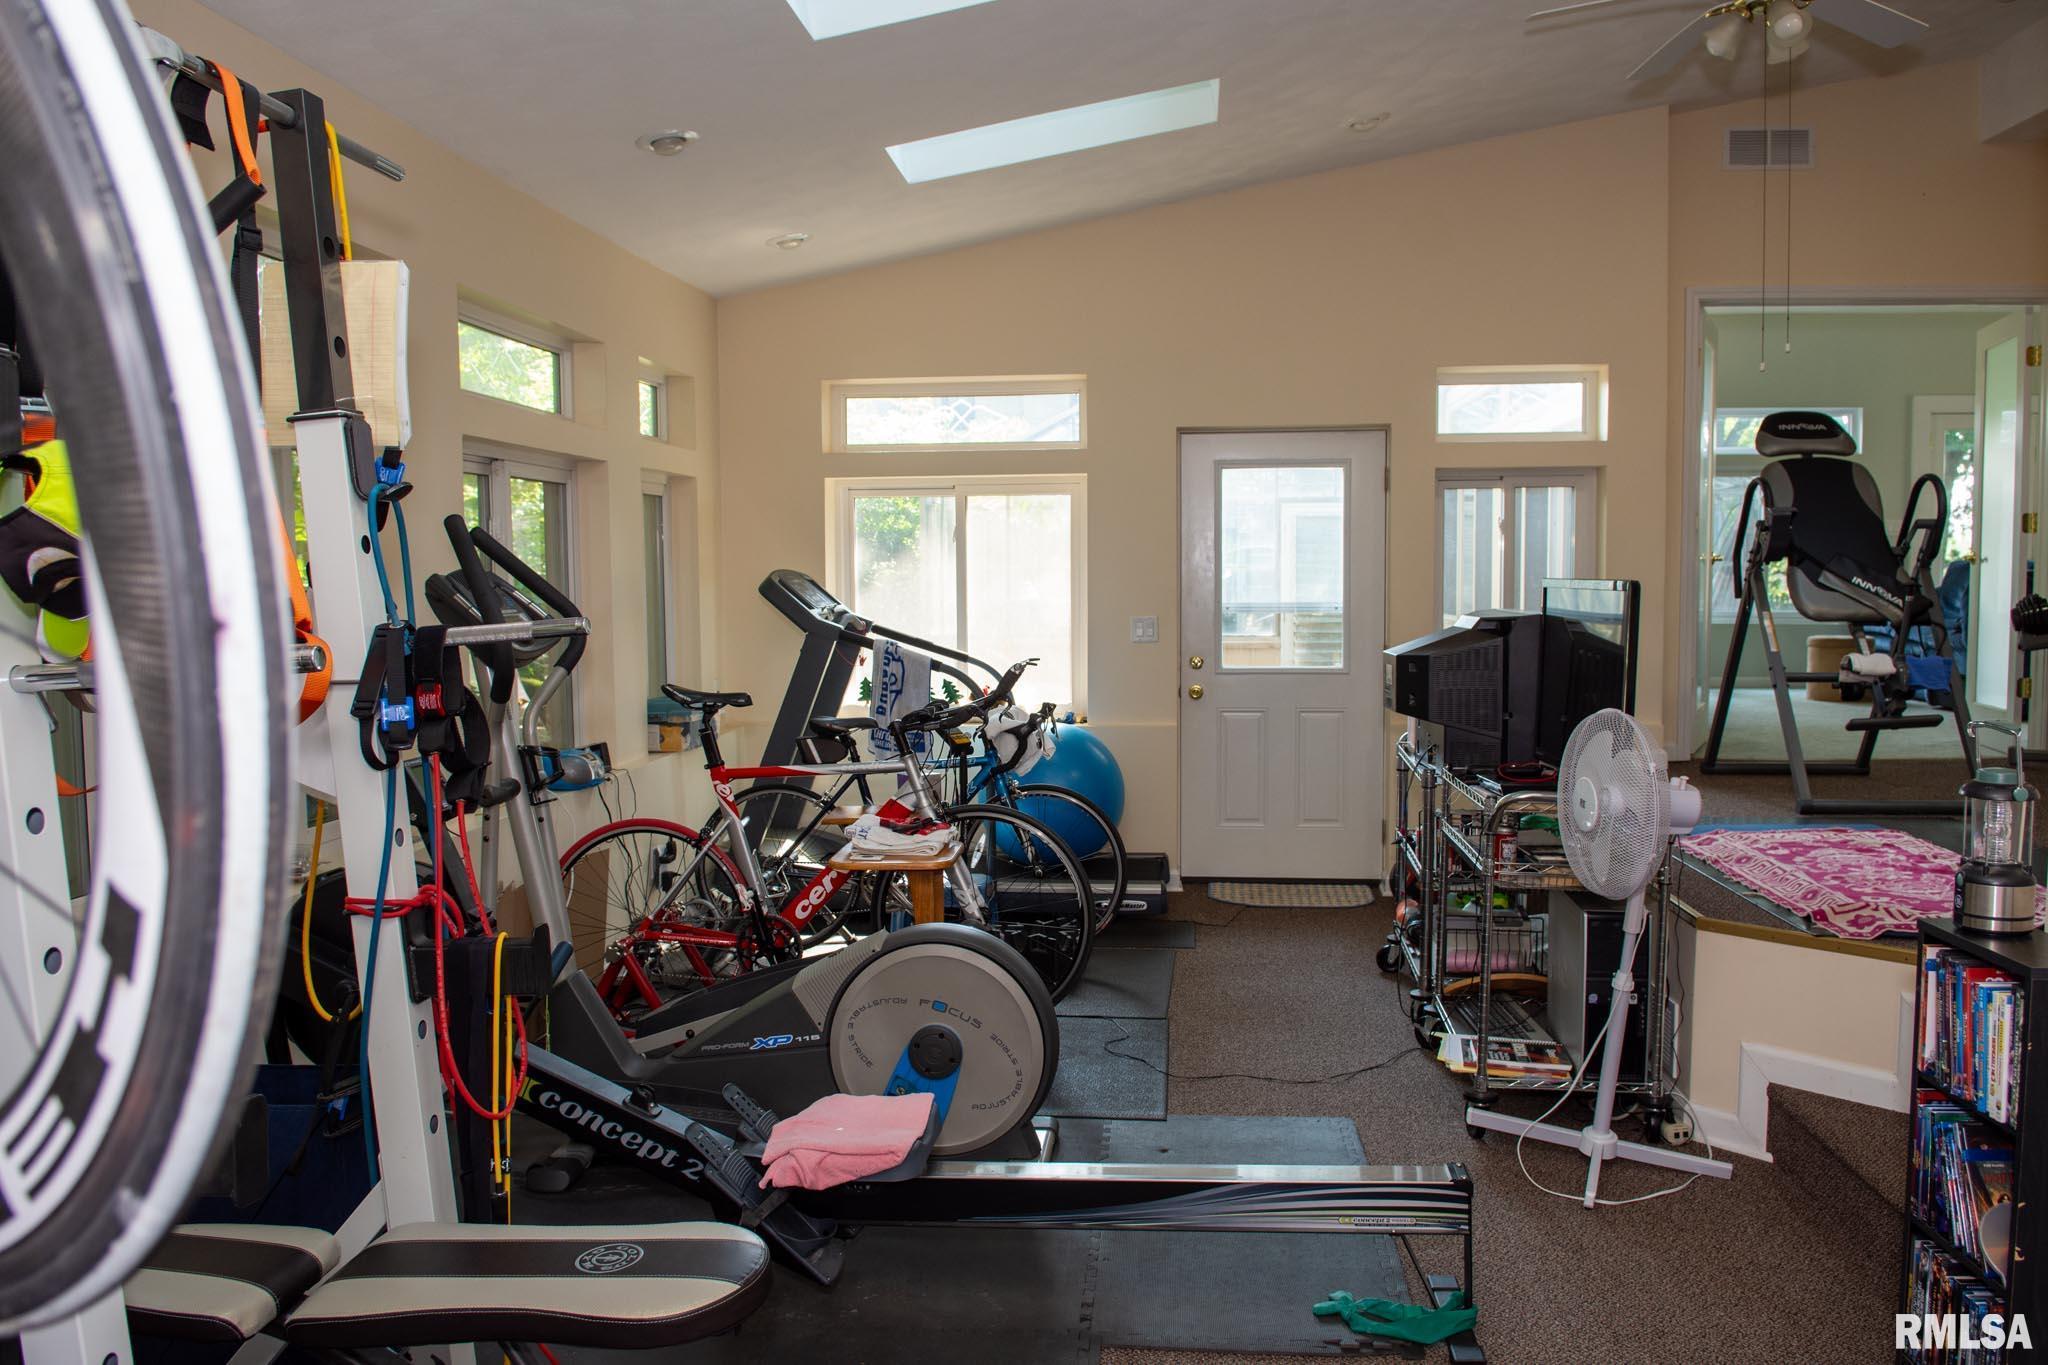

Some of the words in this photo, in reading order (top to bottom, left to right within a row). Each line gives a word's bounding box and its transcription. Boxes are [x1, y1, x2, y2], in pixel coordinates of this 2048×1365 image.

[794, 869, 839, 920] cer
[919, 997, 984, 1030] FOCUS
[749, 1034, 794, 1050] XP
[538, 1091, 680, 1168] concept
[681, 1158, 705, 1181] 2
